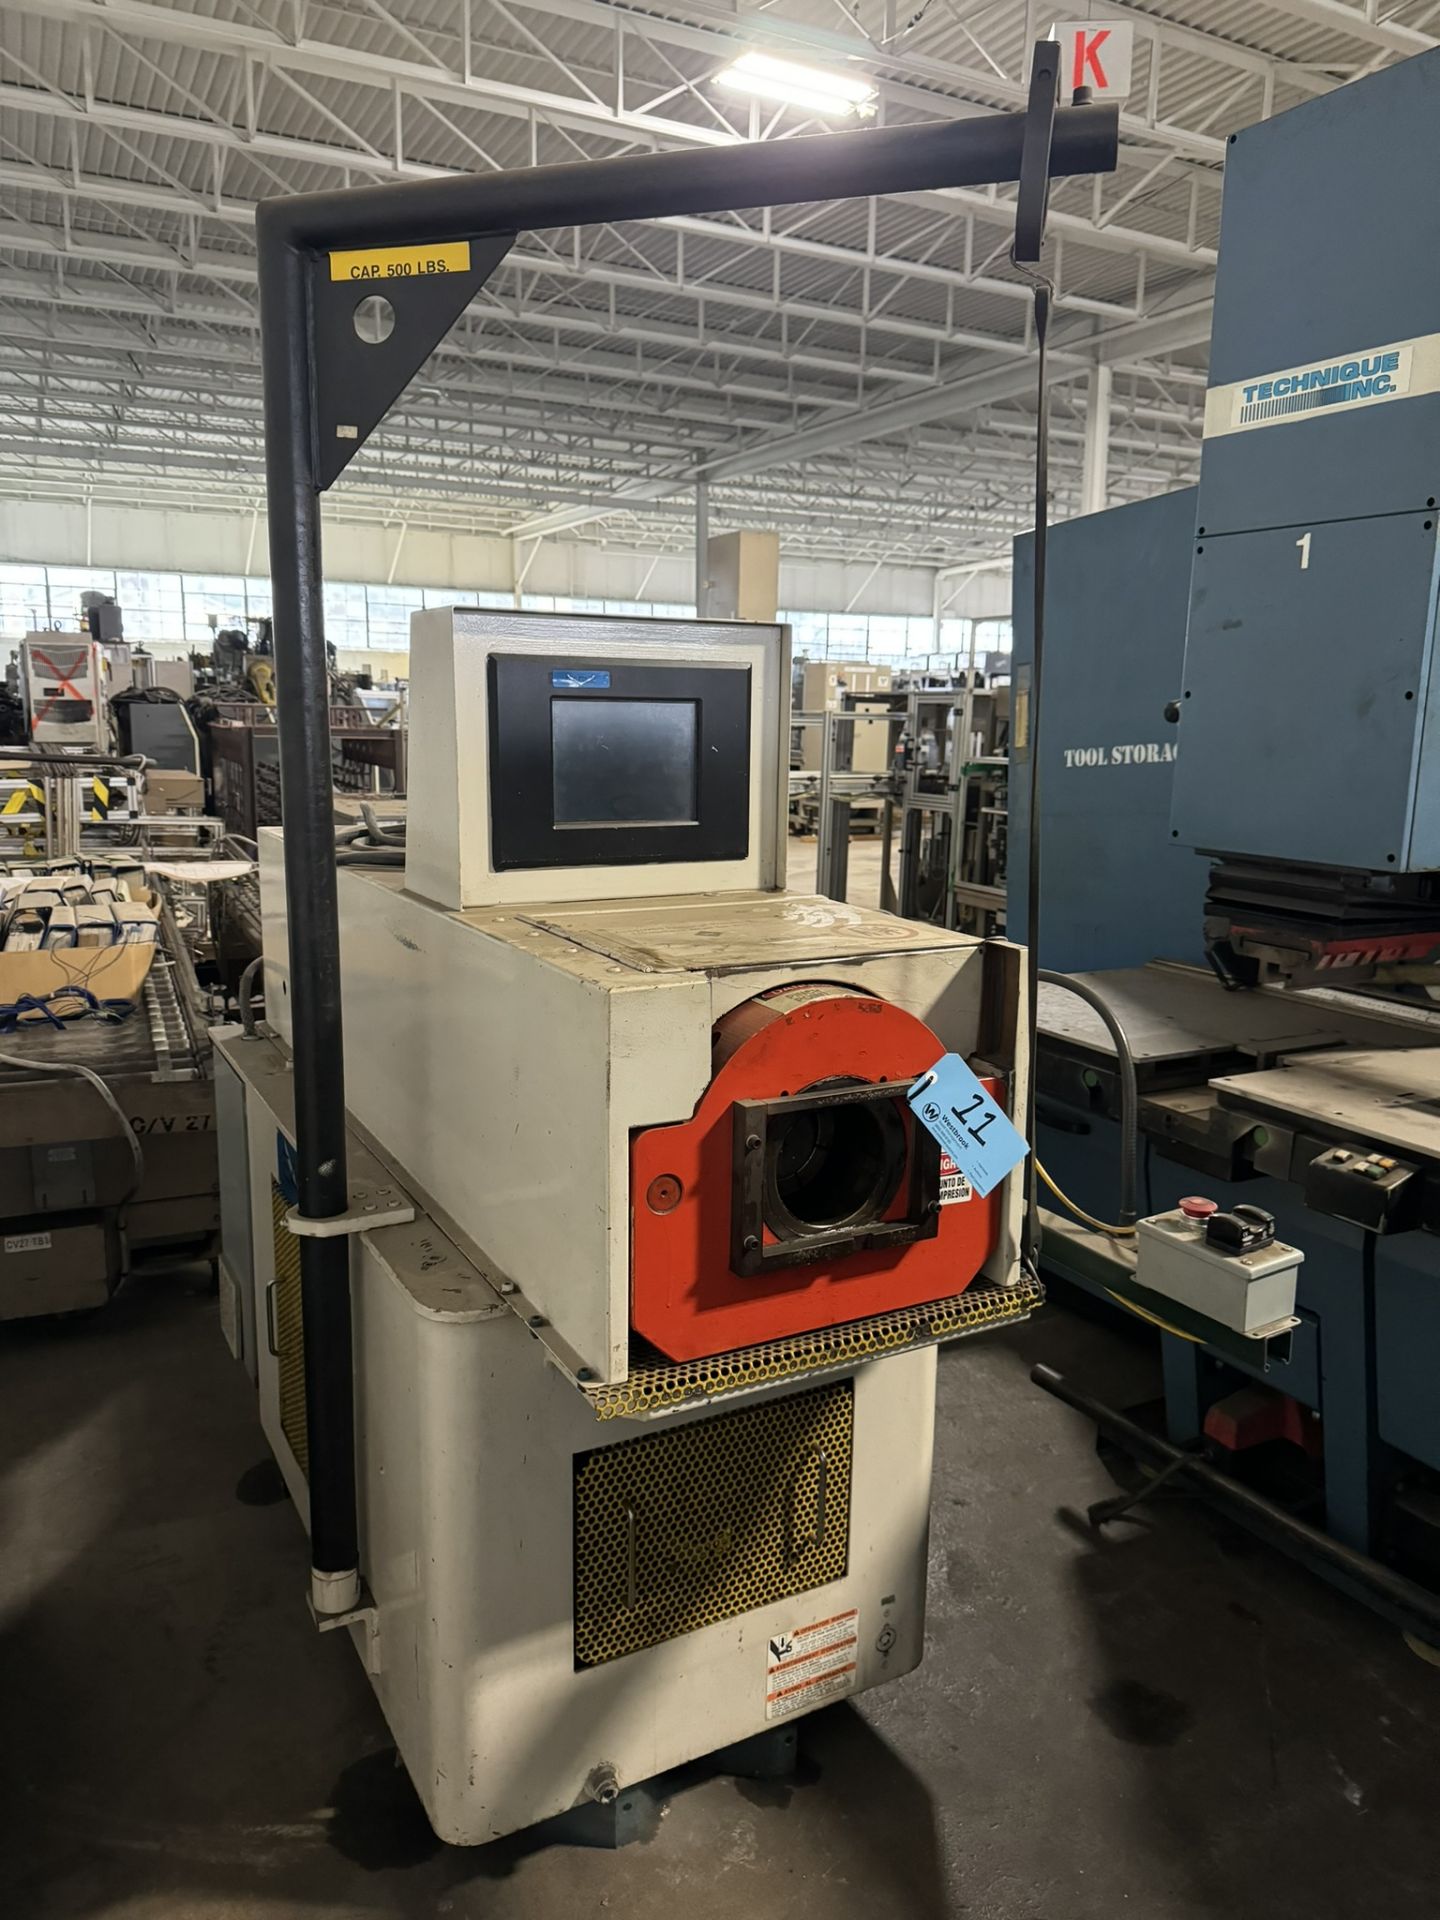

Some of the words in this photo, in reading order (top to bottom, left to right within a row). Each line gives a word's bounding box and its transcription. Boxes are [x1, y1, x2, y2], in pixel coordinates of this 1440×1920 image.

[1072, 29, 1112, 89] K
[350, 264, 381, 279] CAP.
[387, 262, 412, 277] 500
[417, 259, 450, 274] LBS.
[1242, 351, 1400, 404] TECHNIQUE
[1345, 374, 1397, 401] INC.
[1296, 532, 1312, 569] 1
[1064, 747, 1108, 768] TOOL
[1111, 743, 1178, 765] STORA
[186, 1115, 211, 1131] 27
[942, 1114, 969, 1150] Westbrook
[951, 1093, 997, 1147] 11
[957, 1176, 966, 1187] DE
